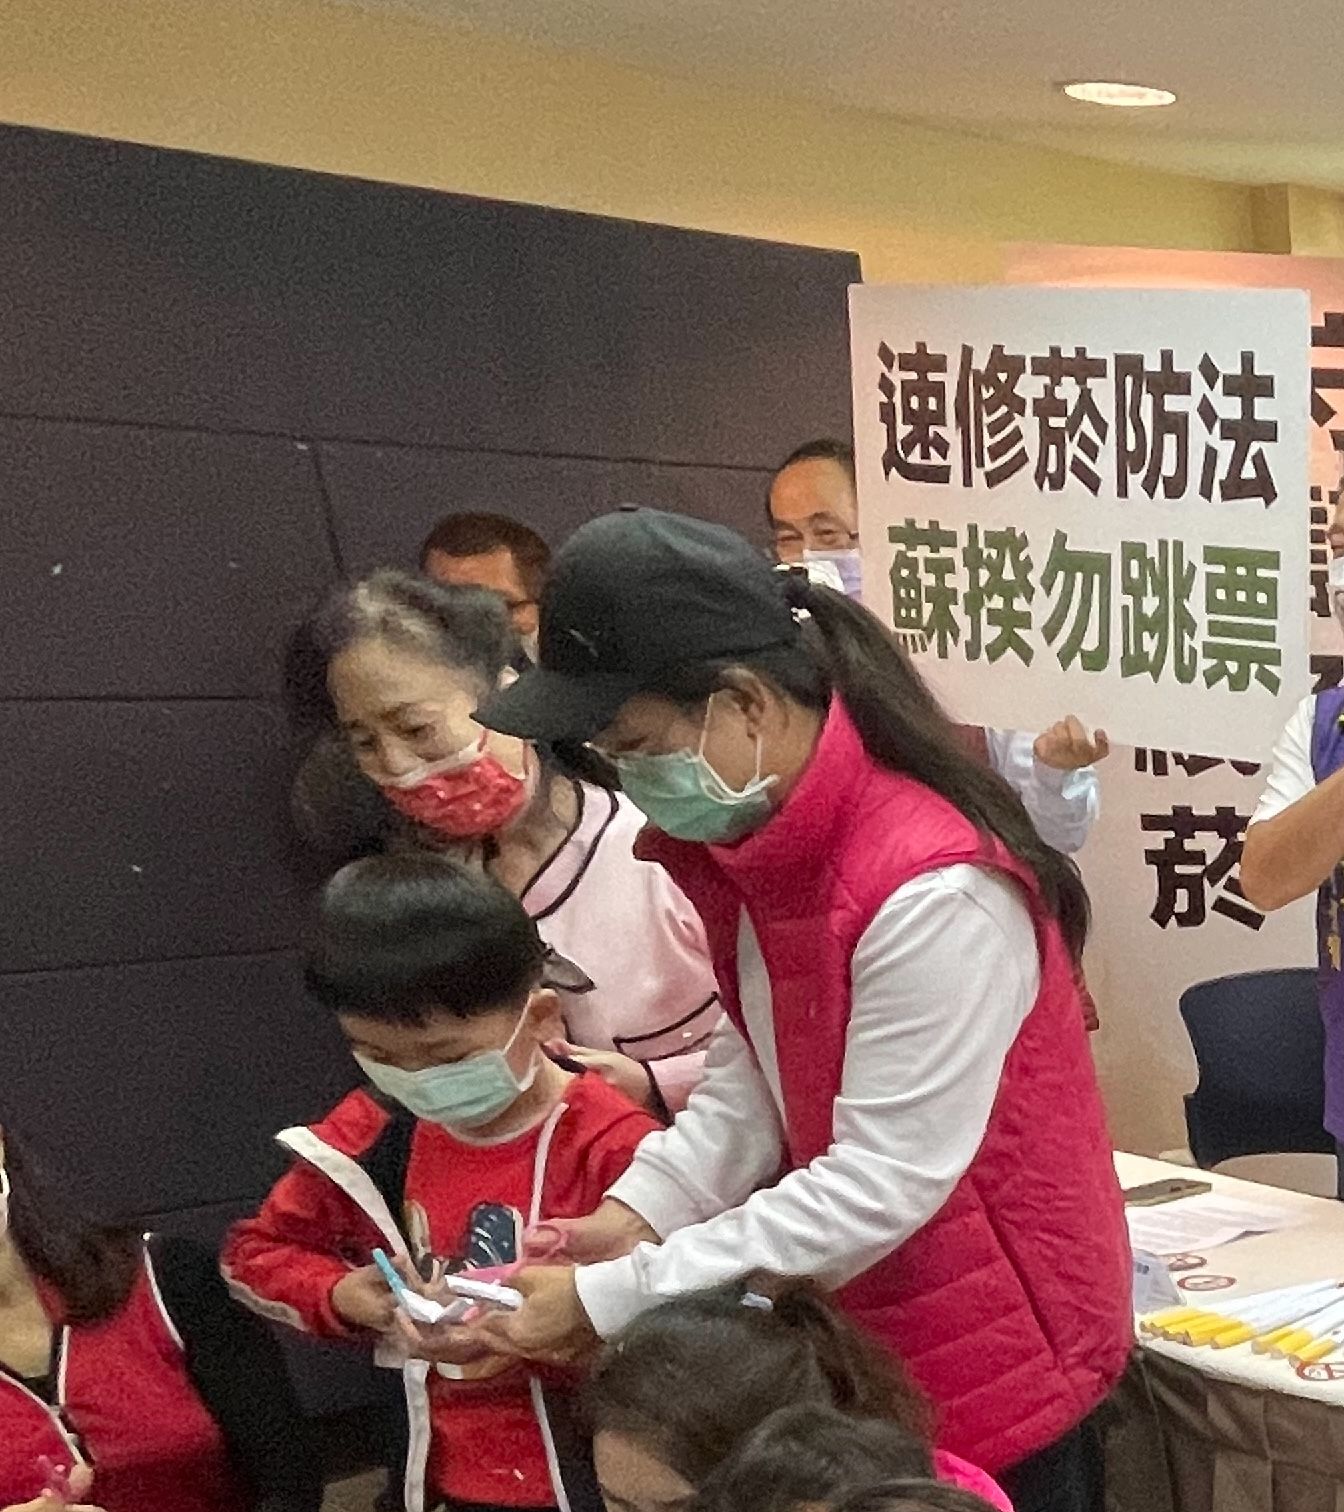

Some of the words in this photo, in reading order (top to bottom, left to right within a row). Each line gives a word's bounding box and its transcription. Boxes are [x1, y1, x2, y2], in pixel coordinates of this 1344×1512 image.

[876, 341, 1279, 508] 速修菸防法
[886, 517, 1283, 697] 蘇揆勿跳票
